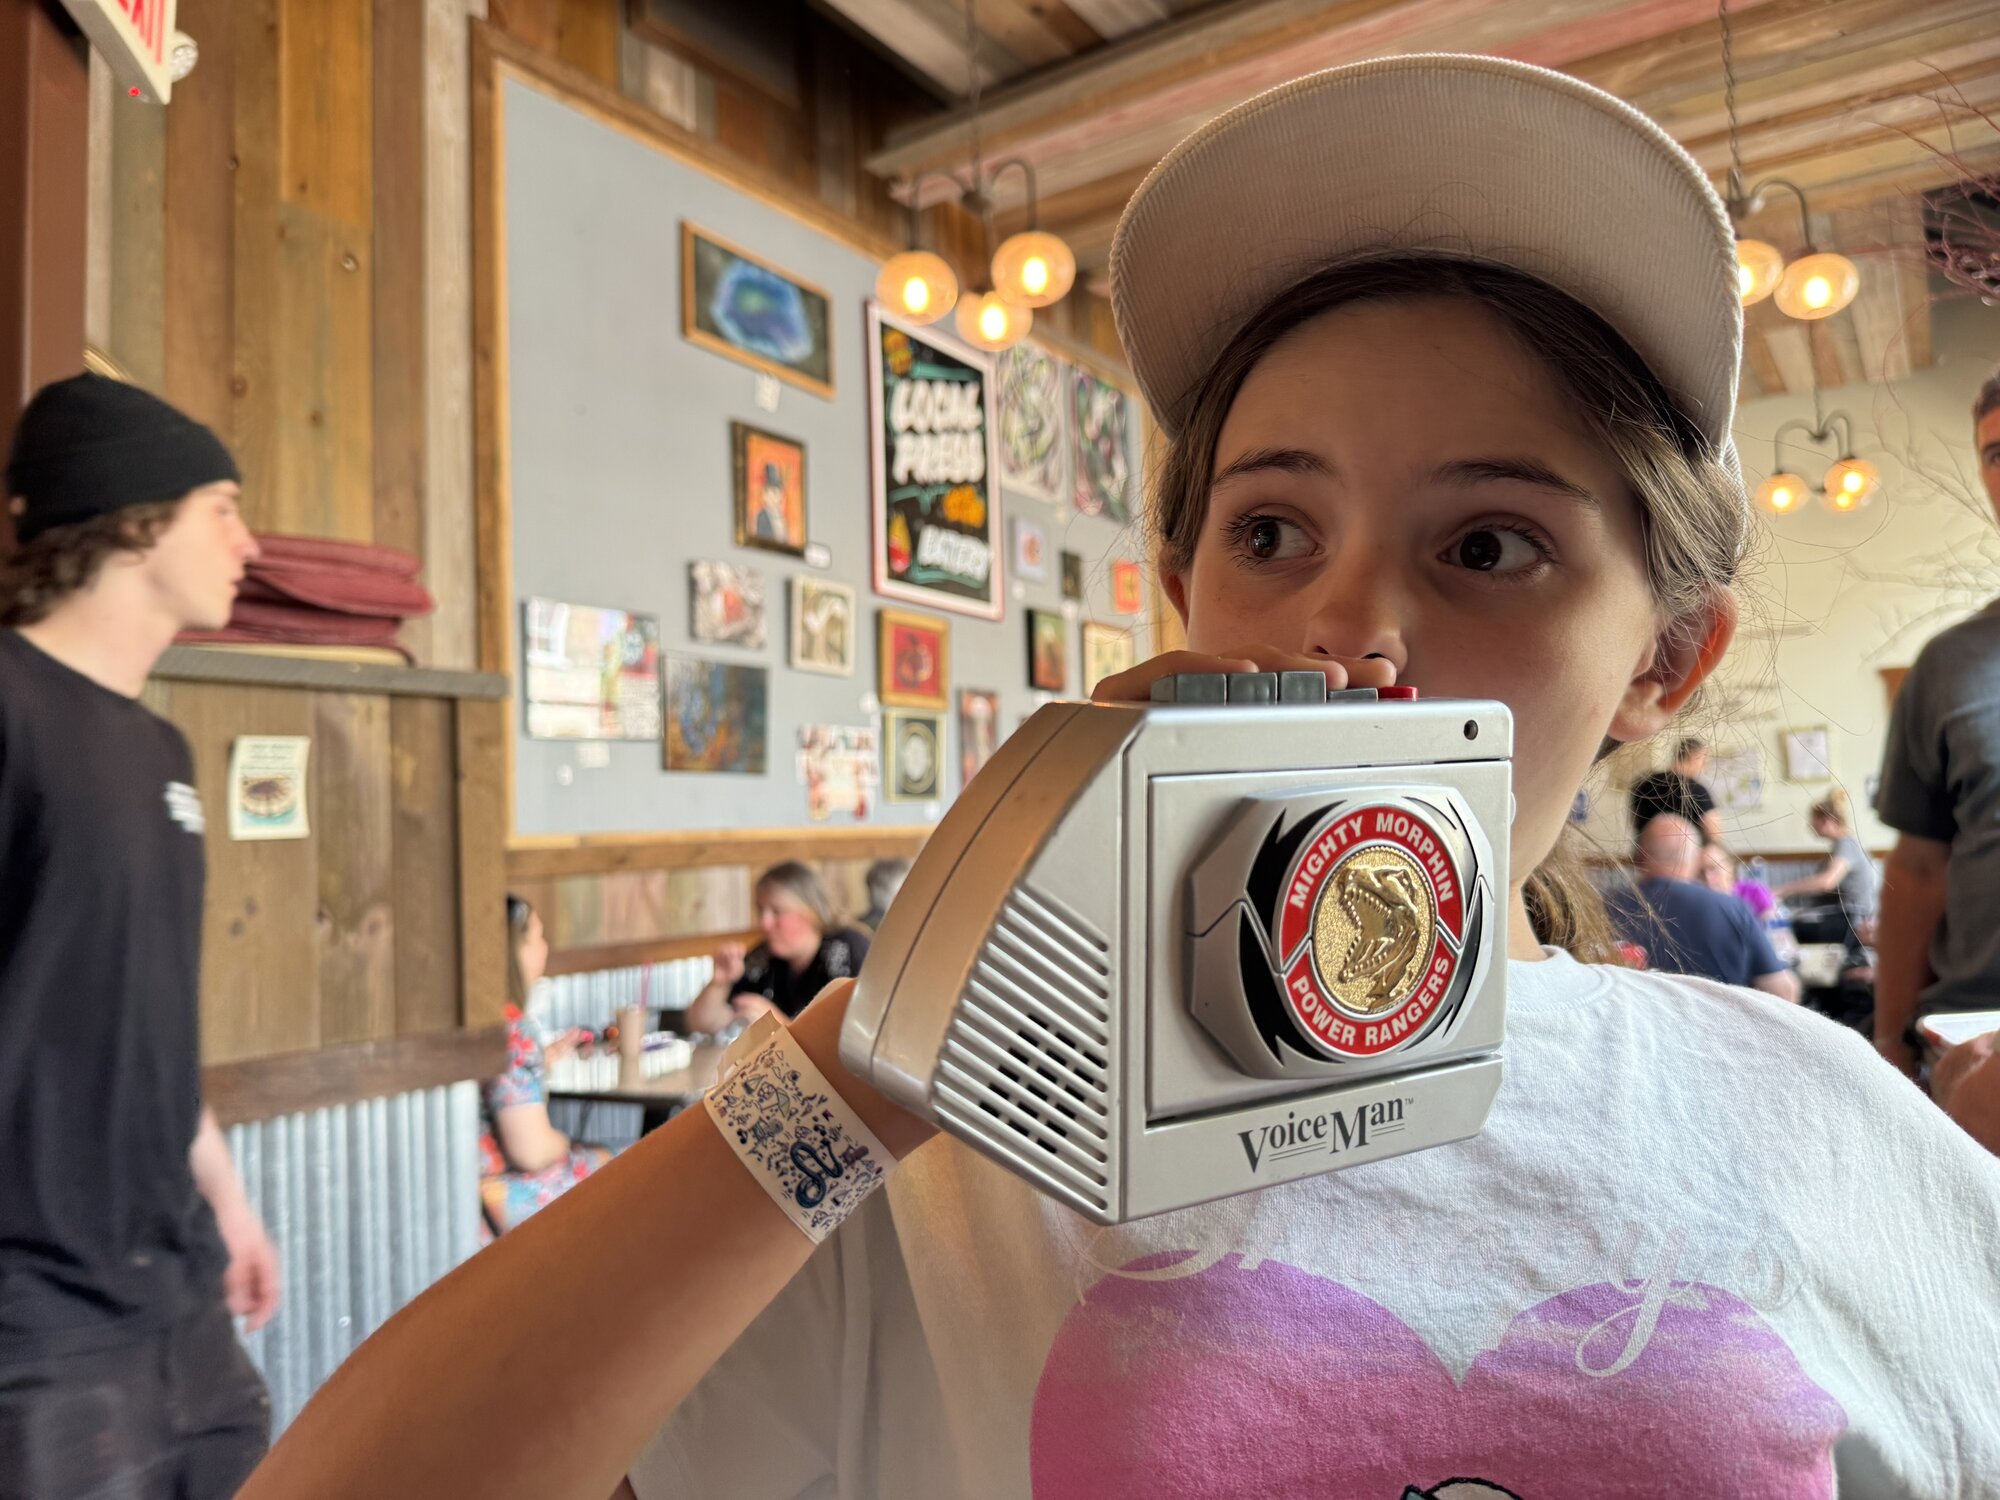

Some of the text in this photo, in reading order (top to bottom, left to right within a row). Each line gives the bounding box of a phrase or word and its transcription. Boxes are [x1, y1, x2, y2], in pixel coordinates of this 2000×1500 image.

[1290, 812, 1453, 909] MIGHTY MORPHIN
[1292, 956, 1449, 1046] POWER RANGERS
